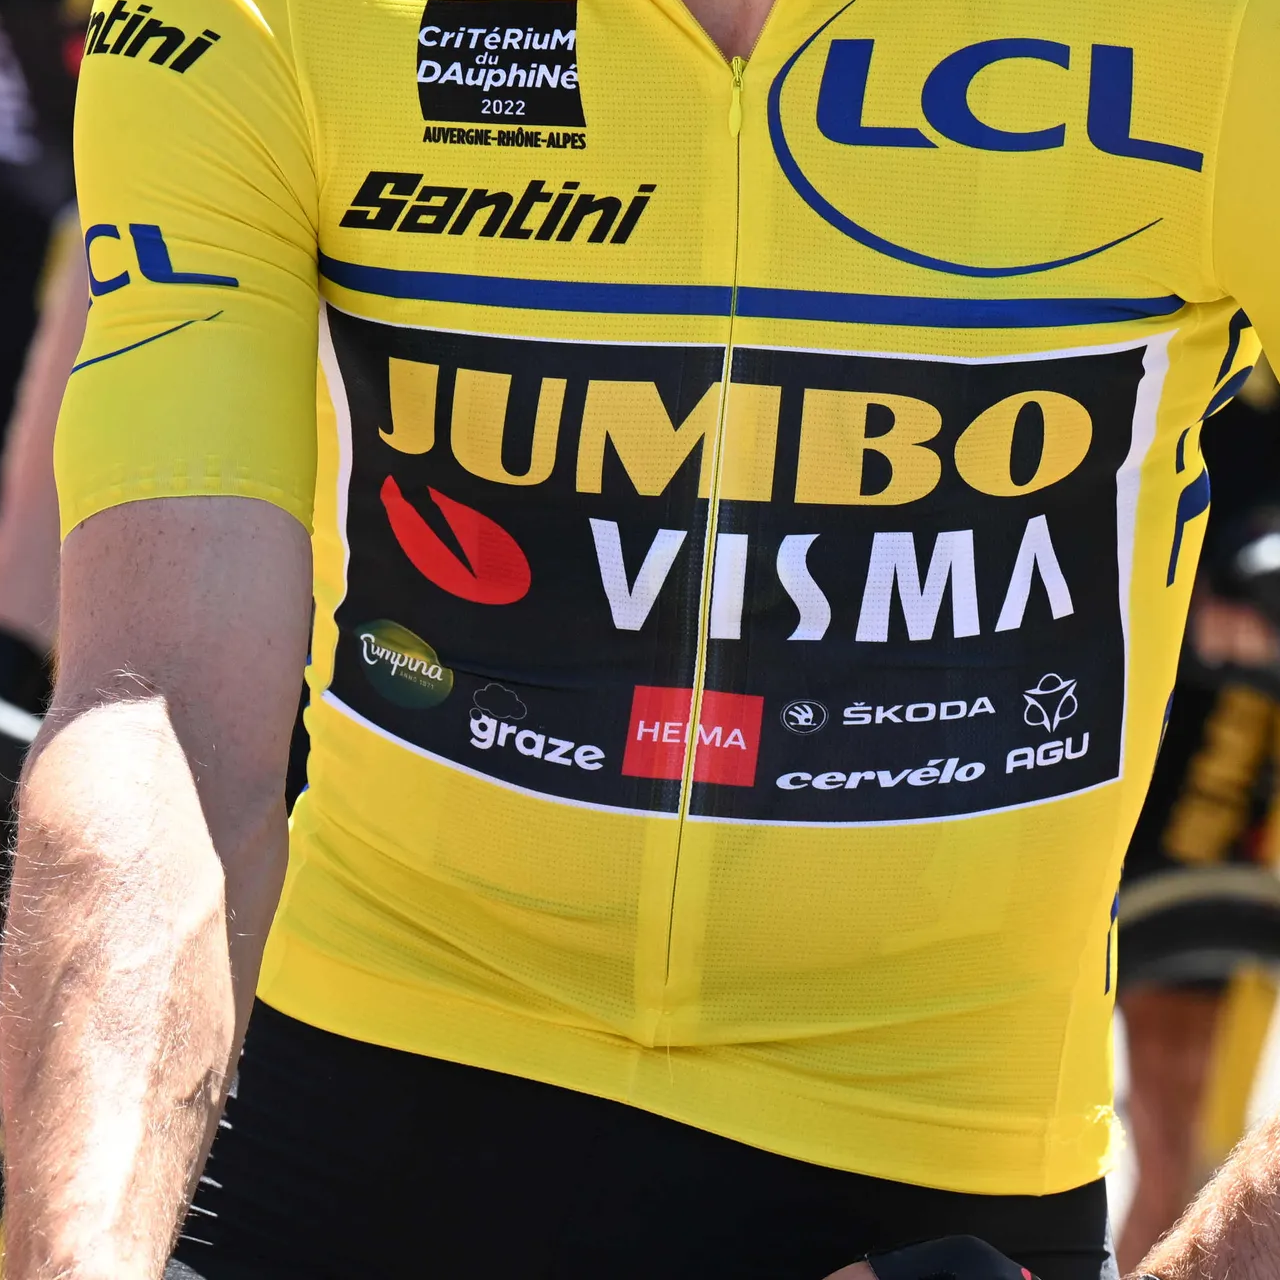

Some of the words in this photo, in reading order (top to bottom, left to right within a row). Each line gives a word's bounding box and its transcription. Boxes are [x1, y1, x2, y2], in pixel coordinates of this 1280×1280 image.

[475, 51, 500, 66] du
[481, 99, 526, 116] 2022
[816, 37, 1204, 173] LCL
[422, 126, 588, 150] AUVERGNE-RHÔNE-ALPES
[338, 171, 658, 245] Santini
[84, 223, 240, 298] CL
[378, 356, 1094, 506] JUMBO
[588, 513, 1075, 643] VISMA
[842, 696, 996, 726] ŠKODA
[470, 712, 606, 771] graze
[1005, 731, 1090, 775] AGU
[775, 756, 987, 791] cervélo
